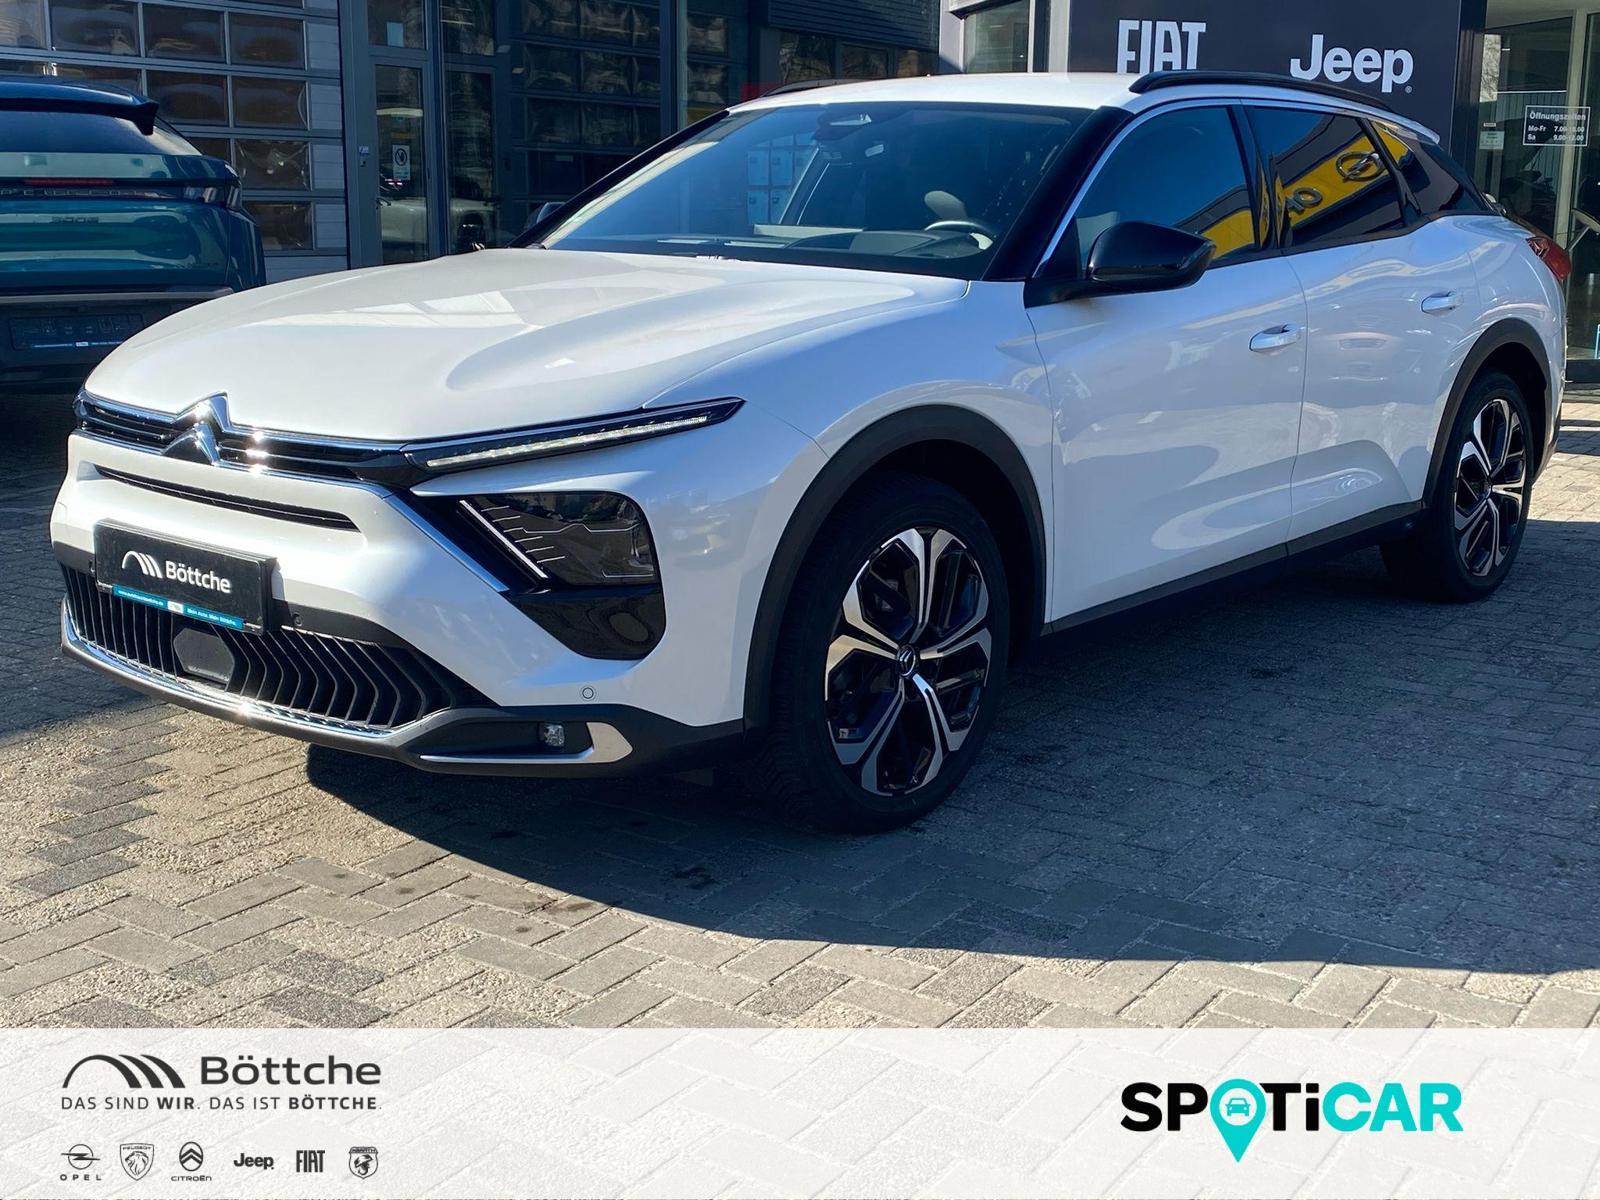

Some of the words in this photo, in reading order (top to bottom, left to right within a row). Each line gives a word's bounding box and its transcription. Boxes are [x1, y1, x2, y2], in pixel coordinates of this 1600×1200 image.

[1117, 19, 1207, 74] FIAT
[1290, 34, 1414, 93] Jeep
[1529, 110, 1587, 122] Öffnungsziten
[165, 560, 232, 594] Böttche
